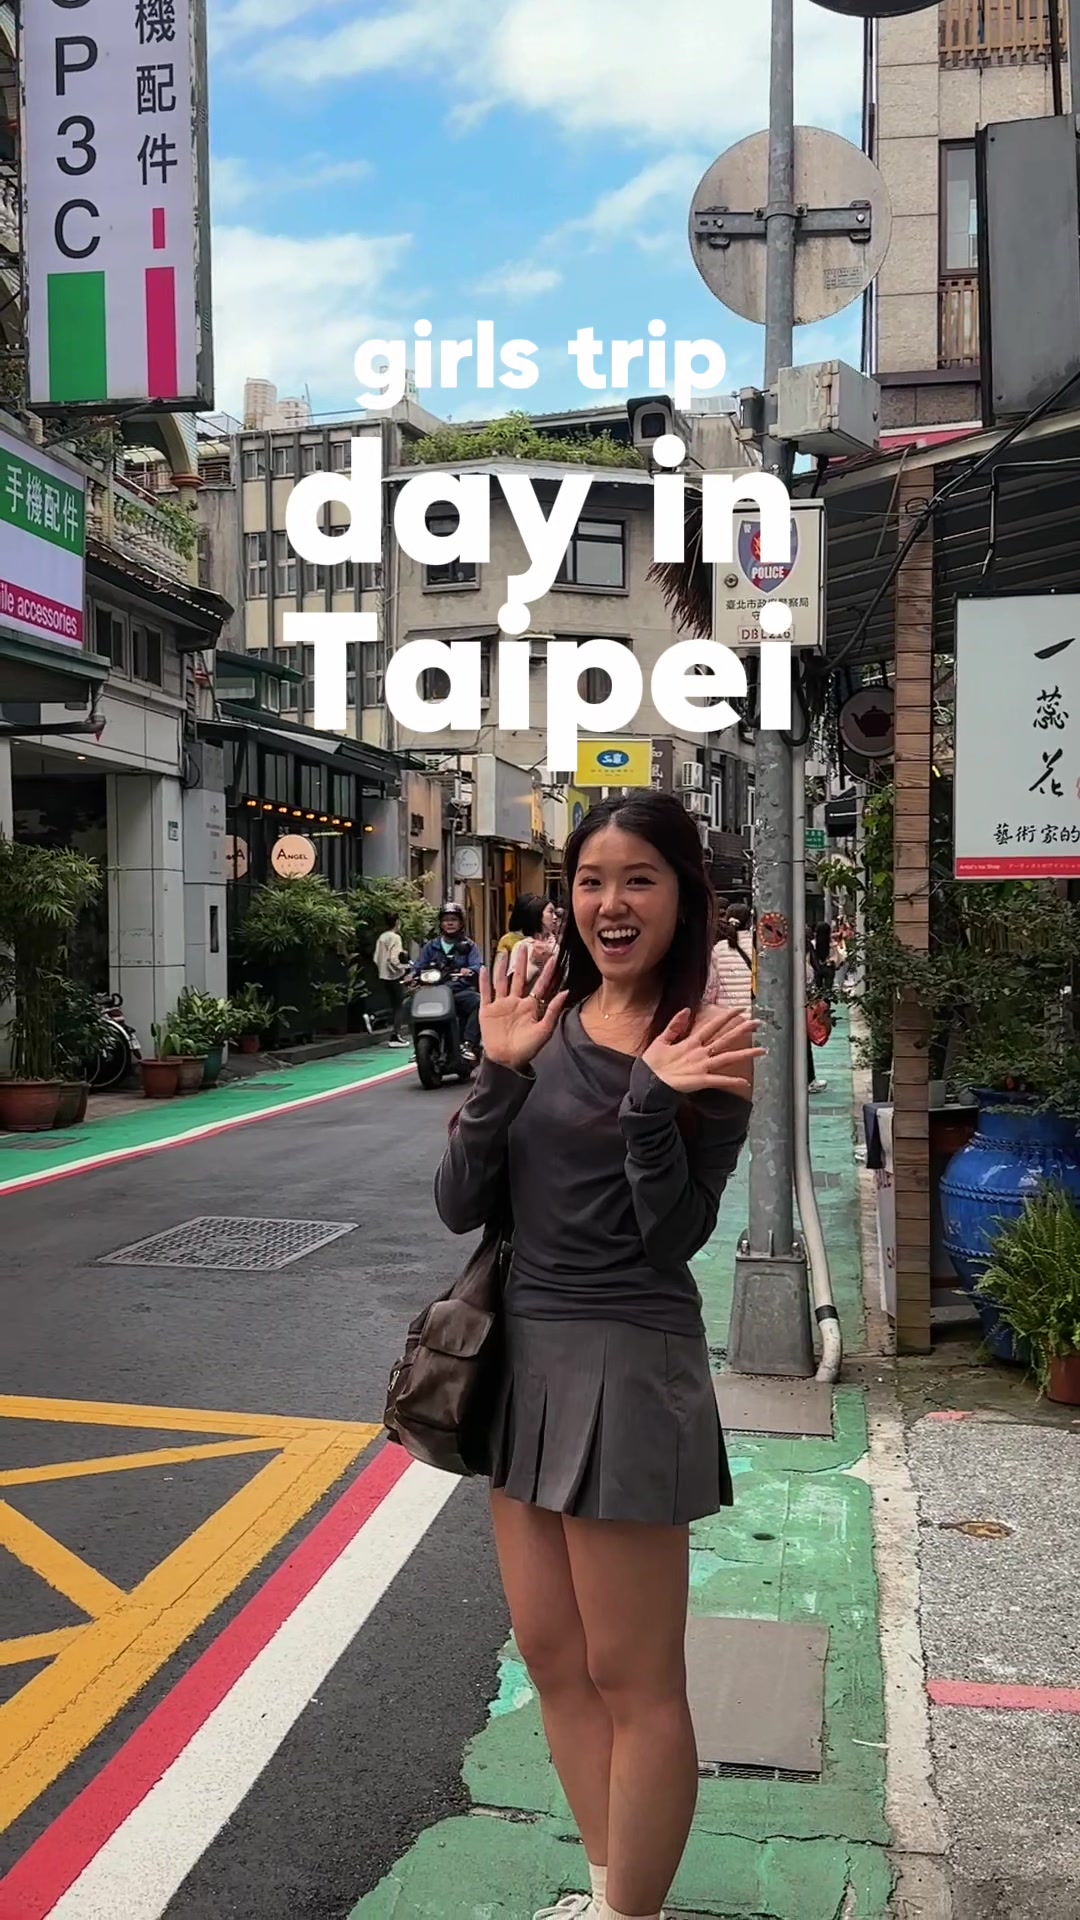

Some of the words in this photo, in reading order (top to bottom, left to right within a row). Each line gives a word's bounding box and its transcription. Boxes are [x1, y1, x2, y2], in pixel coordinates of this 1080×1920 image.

[53, 0, 101, 259] P3C
[135, 0, 178, 186] 機配件
[5, 464, 79, 542] 手機配件
[0, 583, 14, 613] ile
[17, 596, 78, 636] accessories
[751, 566, 785, 579] POLICE
[1029, 638, 1076, 798] 一蕊花
[993, 822, 1080, 846] 藝術家的
